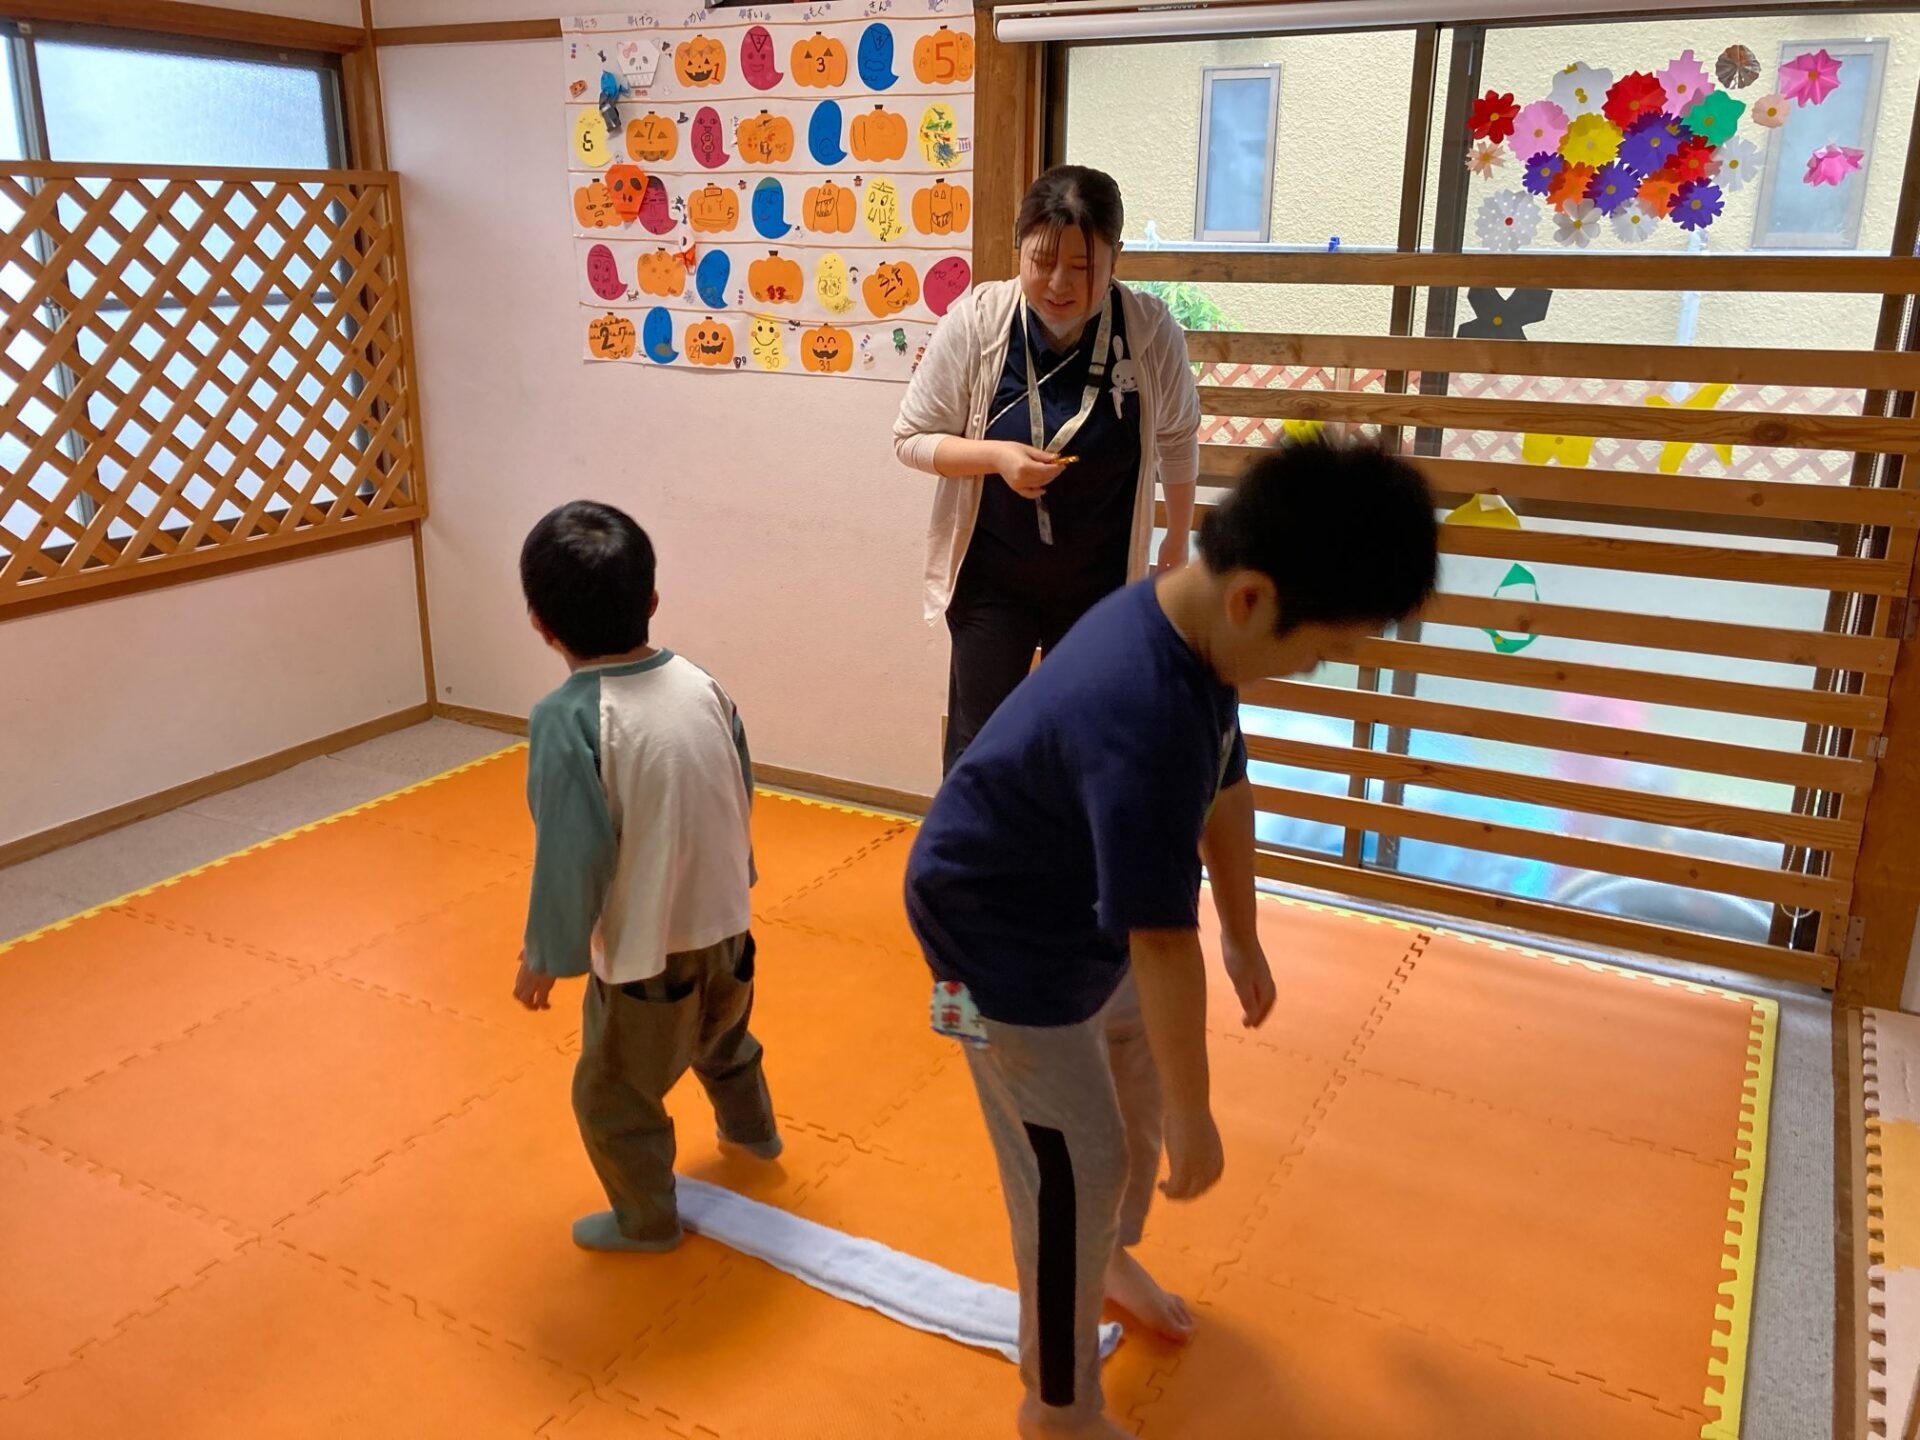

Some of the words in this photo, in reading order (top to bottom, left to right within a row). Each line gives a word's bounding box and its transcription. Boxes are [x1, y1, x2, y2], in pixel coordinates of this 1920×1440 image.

[868, 1, 887, 14] きん
[711, 62, 721, 82] 1
[816, 57, 826, 73] 3
[935, 41, 955, 79] 5
[582, 130, 594, 152] 6
[644, 121, 655, 141] 7
[689, 344, 701, 359] 29
[764, 356, 779, 370] 30
[818, 359, 831, 371] 31
